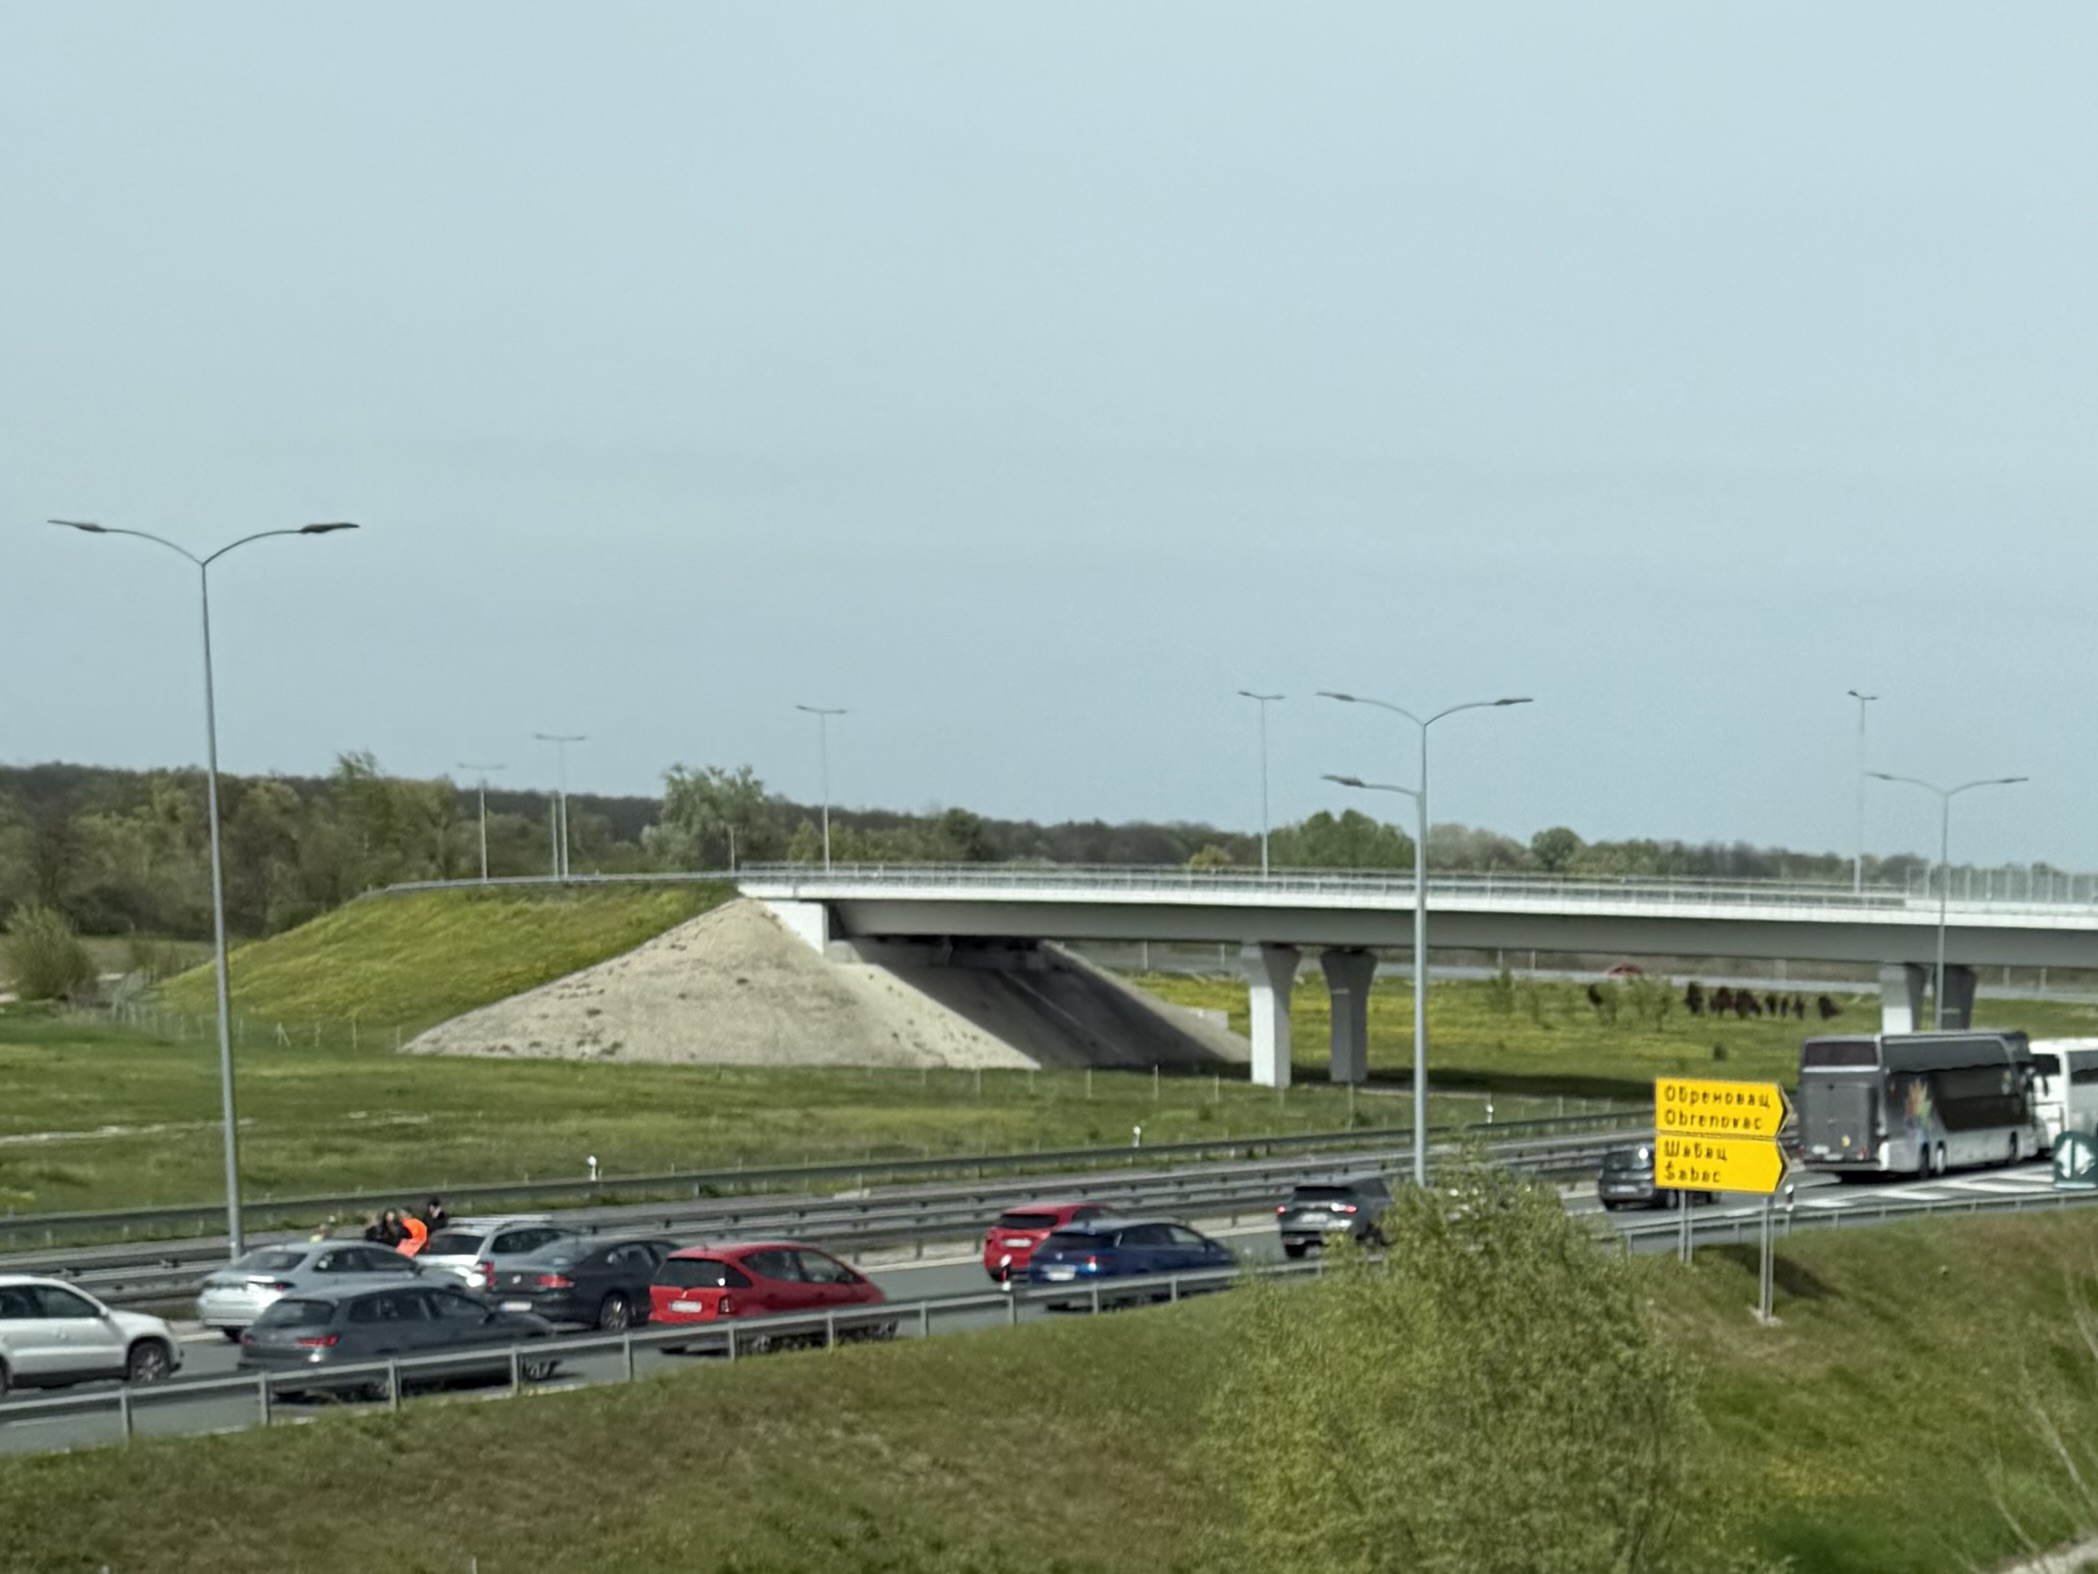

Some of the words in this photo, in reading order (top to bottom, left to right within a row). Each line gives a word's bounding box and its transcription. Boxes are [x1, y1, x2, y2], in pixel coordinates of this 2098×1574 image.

[1664, 1085, 1770, 1108] Обреновац
[1664, 1109, 1762, 1130] Obrenovac
[1664, 1140, 1727, 1161] Шабац
[1665, 1161, 1721, 1183] Šabac
